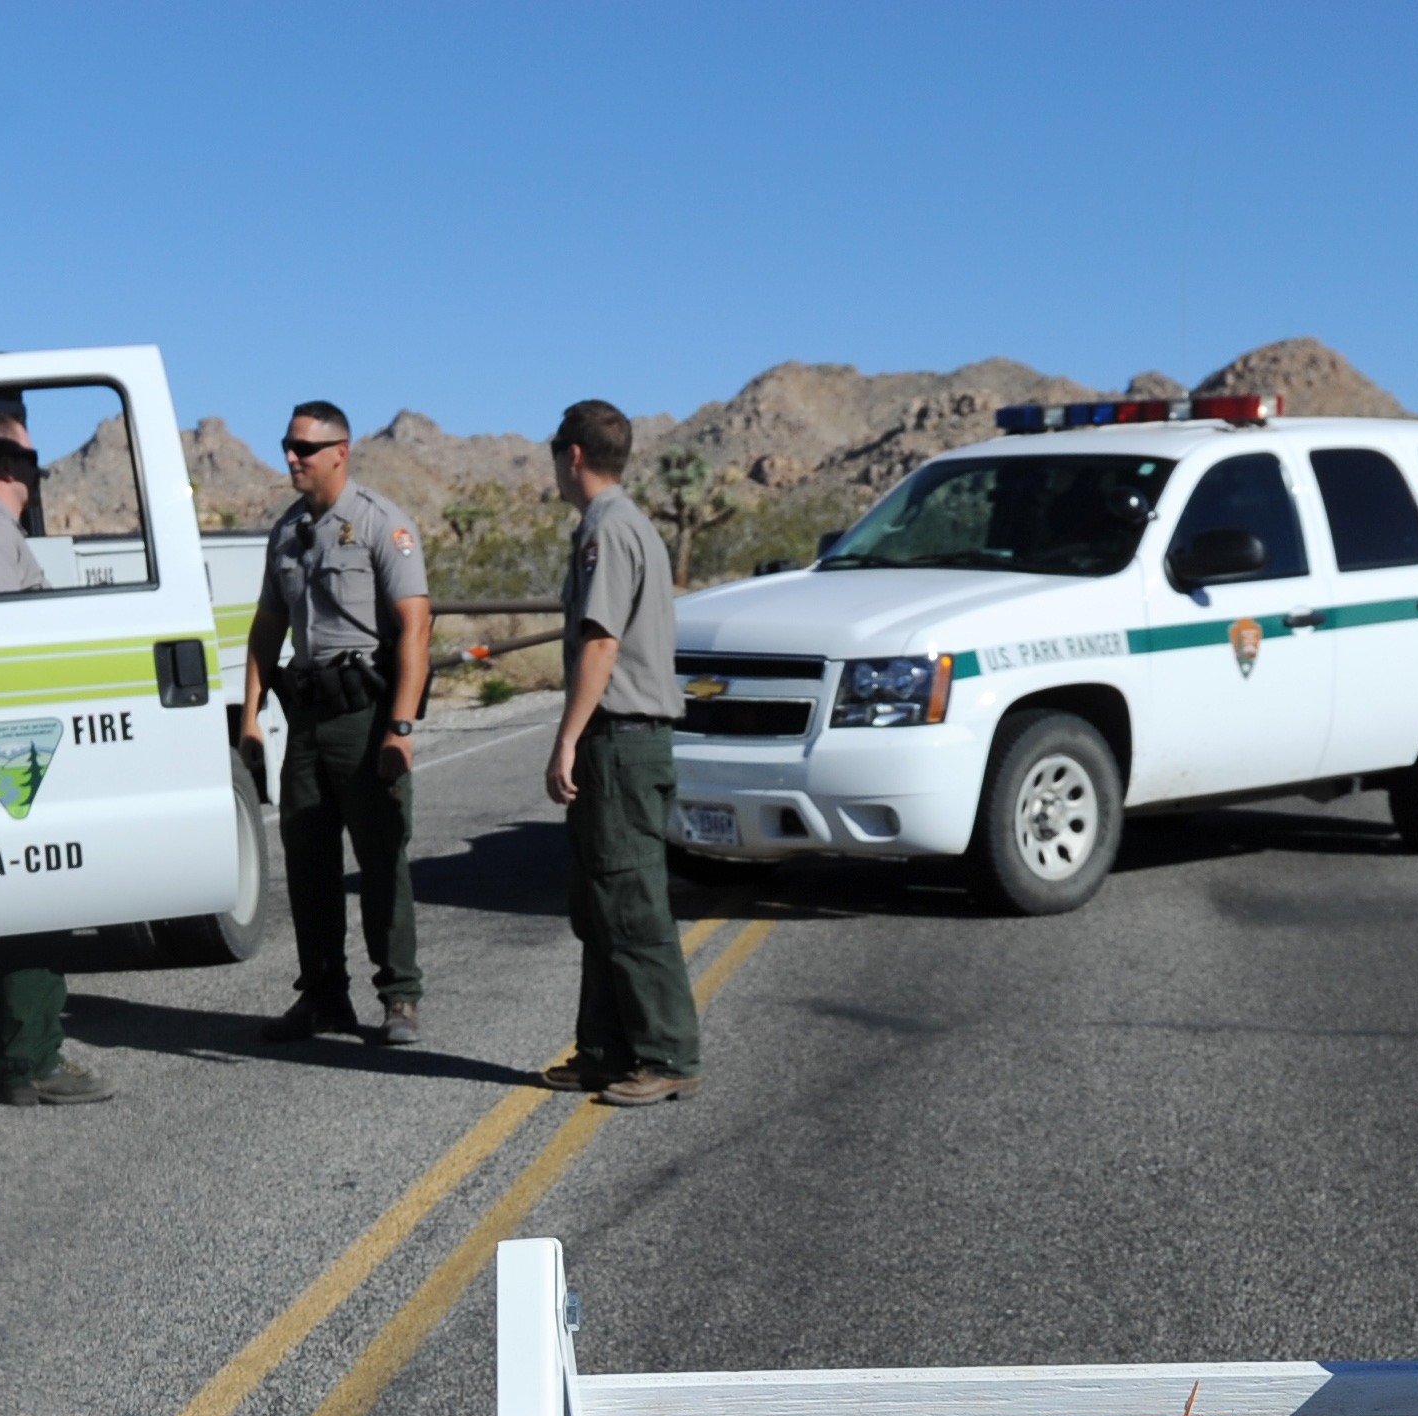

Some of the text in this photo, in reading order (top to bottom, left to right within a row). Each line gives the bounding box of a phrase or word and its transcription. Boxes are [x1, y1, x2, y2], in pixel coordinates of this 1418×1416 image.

[1018, 639, 1064, 665] PARK
[1064, 632, 1125, 660] RANGER
[72, 711, 134, 745] FIRE
